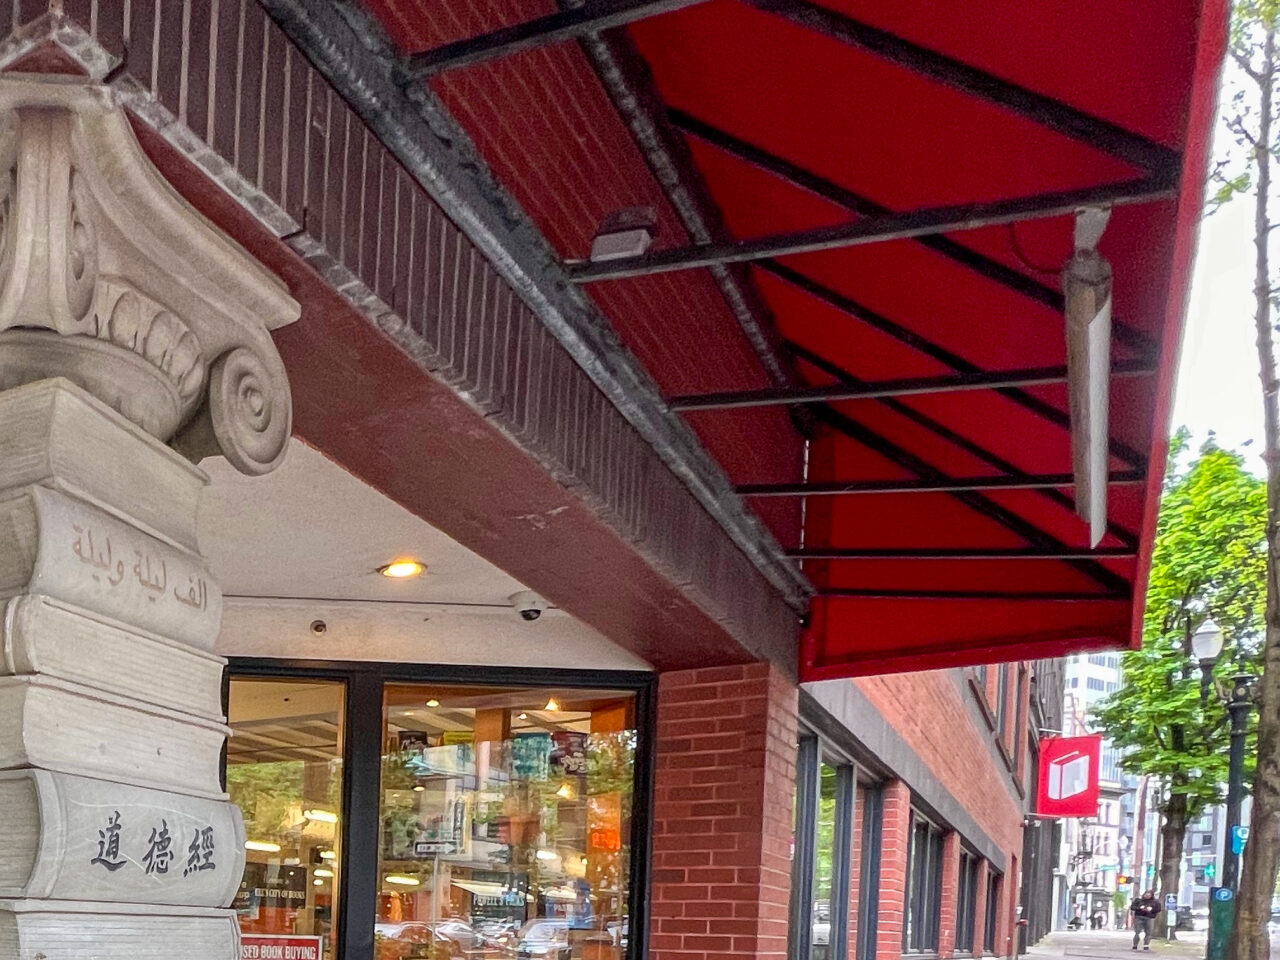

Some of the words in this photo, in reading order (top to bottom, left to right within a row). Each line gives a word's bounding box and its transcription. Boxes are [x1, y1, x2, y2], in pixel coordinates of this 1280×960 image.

[134, 549, 167, 602] ليلة
[90, 810, 216, 878] 道德經
[261, 945, 283, 959] BOOK
[284, 946, 317, 960] BUYING
